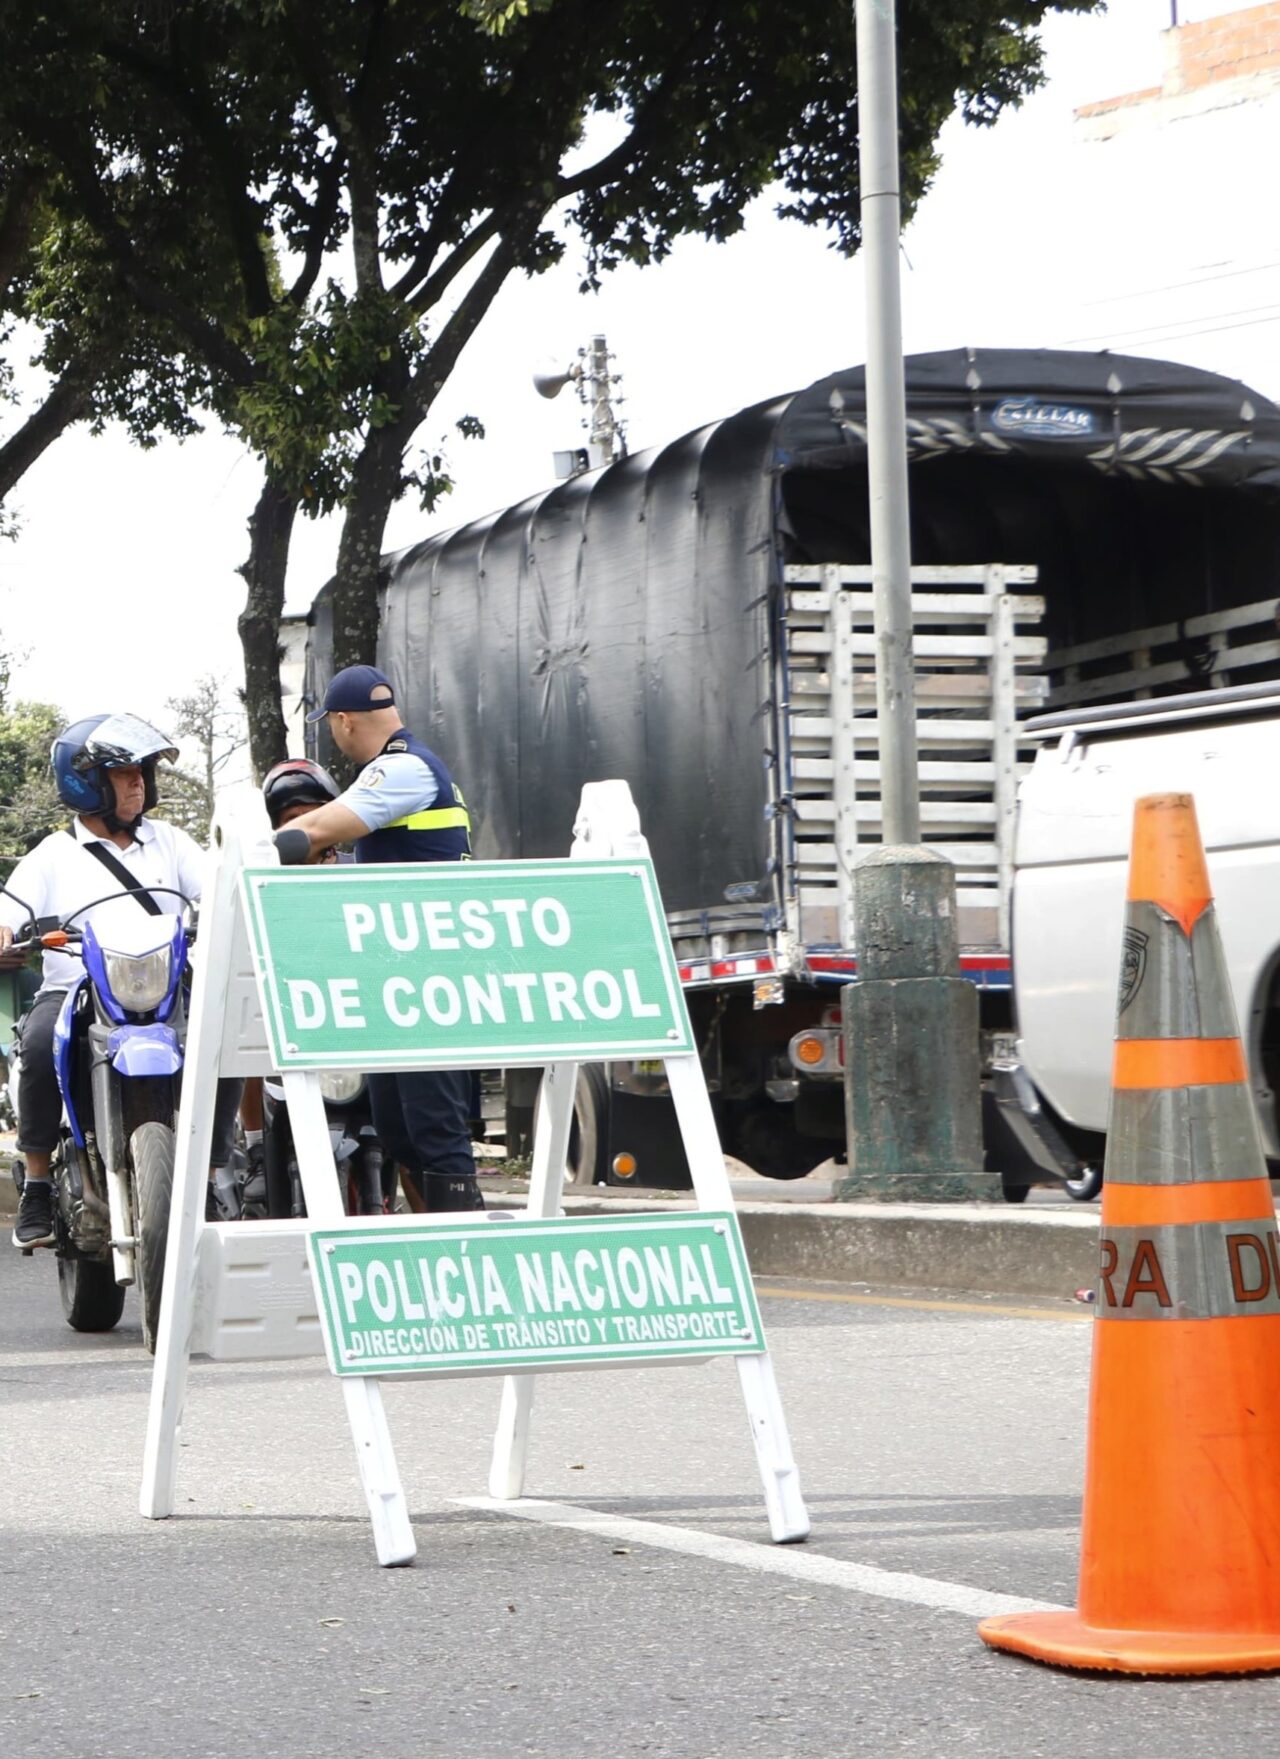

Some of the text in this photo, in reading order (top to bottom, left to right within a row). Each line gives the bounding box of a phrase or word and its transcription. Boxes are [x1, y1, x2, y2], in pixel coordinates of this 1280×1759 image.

[342, 897, 571, 952] PUESTO
[287, 968, 662, 1029] DE CONTROL
[337, 1240, 733, 1323] POLICÍA NACIONAL
[462, 1324, 490, 1350] DE
[593, 1317, 607, 1343] Y
[612, 1311, 739, 1342] TRANSPORTE
